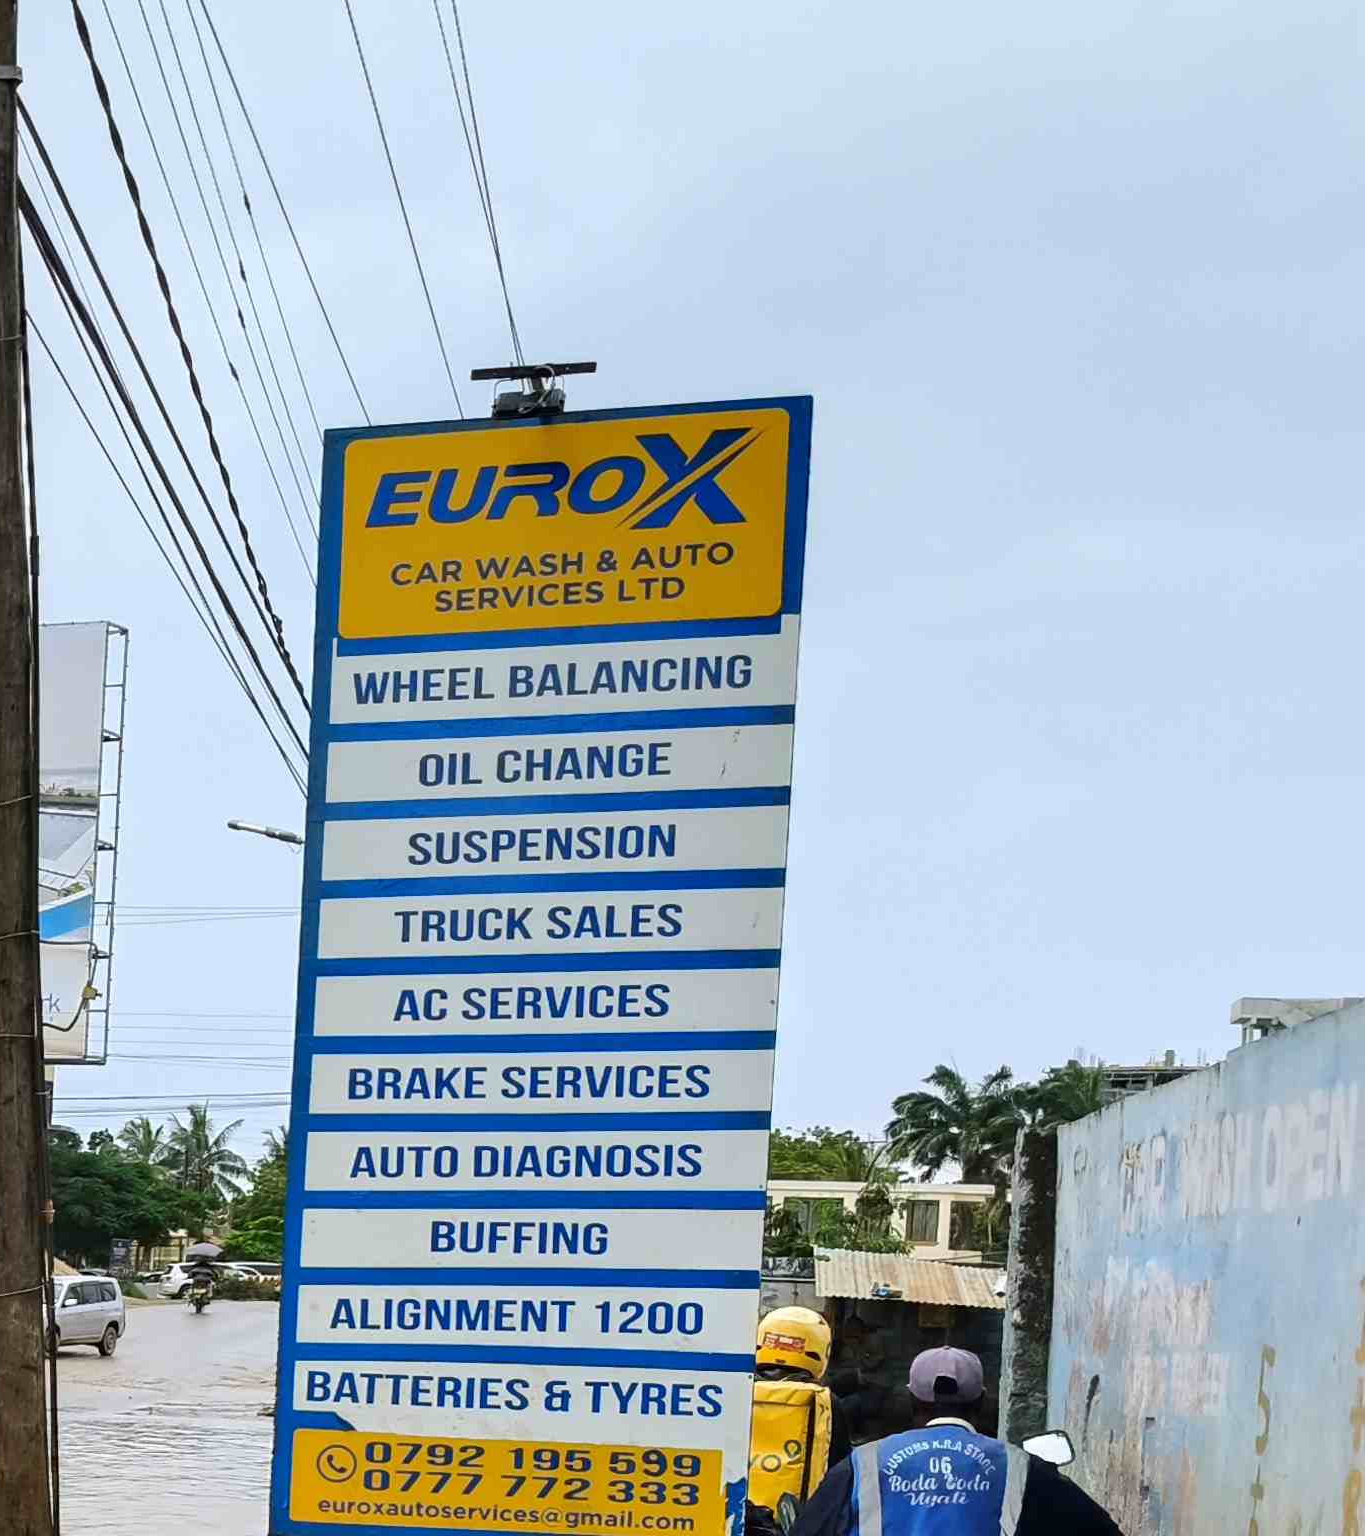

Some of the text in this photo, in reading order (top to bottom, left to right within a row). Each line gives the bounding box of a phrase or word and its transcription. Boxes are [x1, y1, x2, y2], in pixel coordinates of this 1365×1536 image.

[364, 426, 767, 531] EUROX
[390, 541, 735, 587] CAR WASH & AUTO
[434, 576, 687, 614] SERVICES LTD
[353, 654, 754, 706] WHEEL BALANCING
[418, 742, 673, 787] OIL CHANGE
[407, 824, 677, 866] SUSPENSION
[394, 903, 684, 944] TRUCK SALES
[393, 984, 670, 1022] AC SERVICES
[347, 1064, 711, 1101] BRAKE SERVICES
[349, 1143, 703, 1180] AUTO DIAGNOSIS
[430, 1220, 609, 1256] BUFFING
[329, 1297, 705, 1336] ALIGNMENT 1200
[306, 1370, 723, 1418] BATTERIES & TYRES
[364, 1441, 701, 1477] 0792 195 599
[929, 1456, 952, 1474] 06
[362, 1469, 699, 1507] 0777 772 333
[889, 1474, 938, 1492] Boda
[317, 1498, 695, 1532] euroxautoservices@gmail.com
